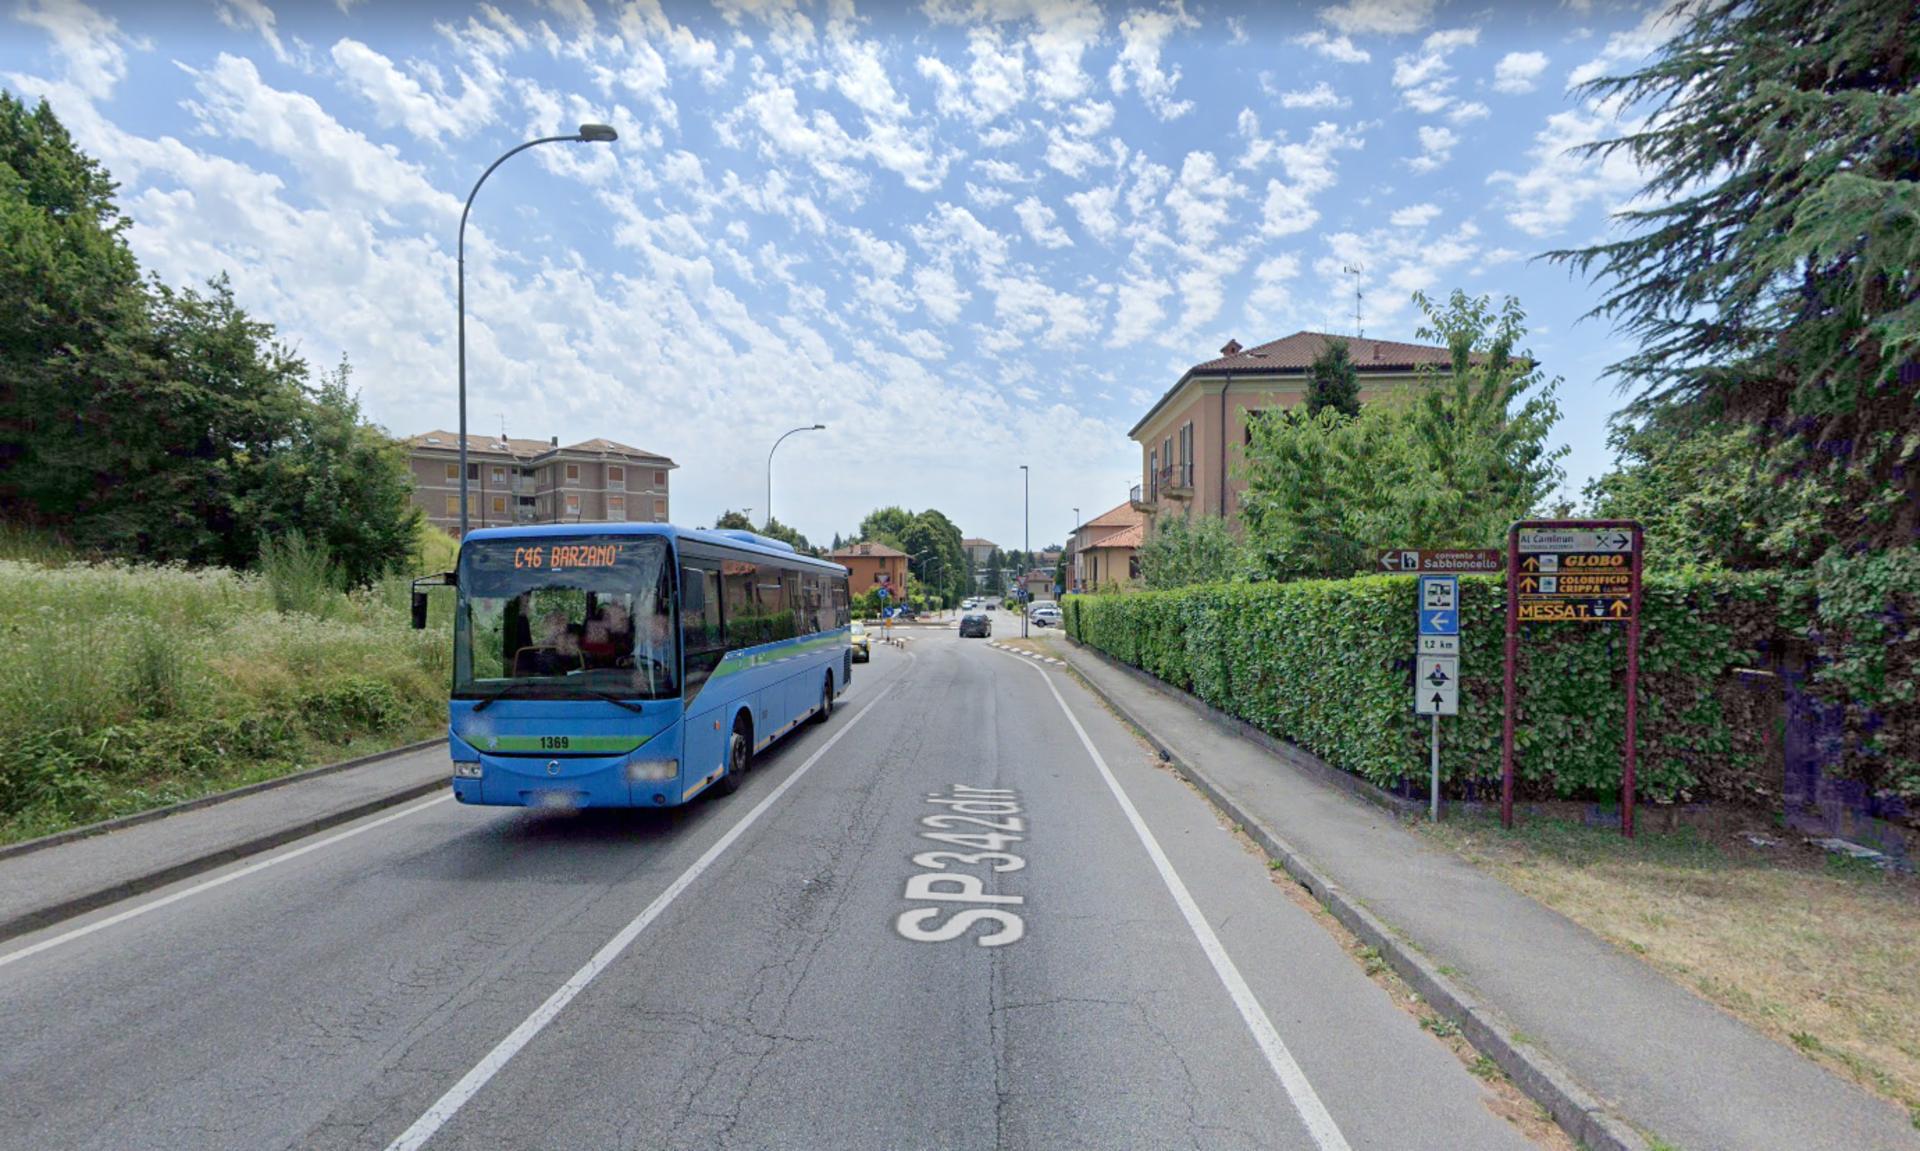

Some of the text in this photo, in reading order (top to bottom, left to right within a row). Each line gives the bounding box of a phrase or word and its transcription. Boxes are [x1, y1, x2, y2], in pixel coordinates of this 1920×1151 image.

[515, 544, 624, 569] C46 BARZANO'
[1435, 551, 1486, 560] convento di
[1564, 554, 1624, 567] GLOBO
[1424, 558, 1497, 569] Sabbioncello
[1559, 575, 1629, 585] COLORIFICIO
[1559, 584, 1601, 593] CRIPPA
[1518, 604, 1576, 618] MESSA
[1424, 640, 1453, 650] 1,2 km
[540, 736, 570, 749] 1369
